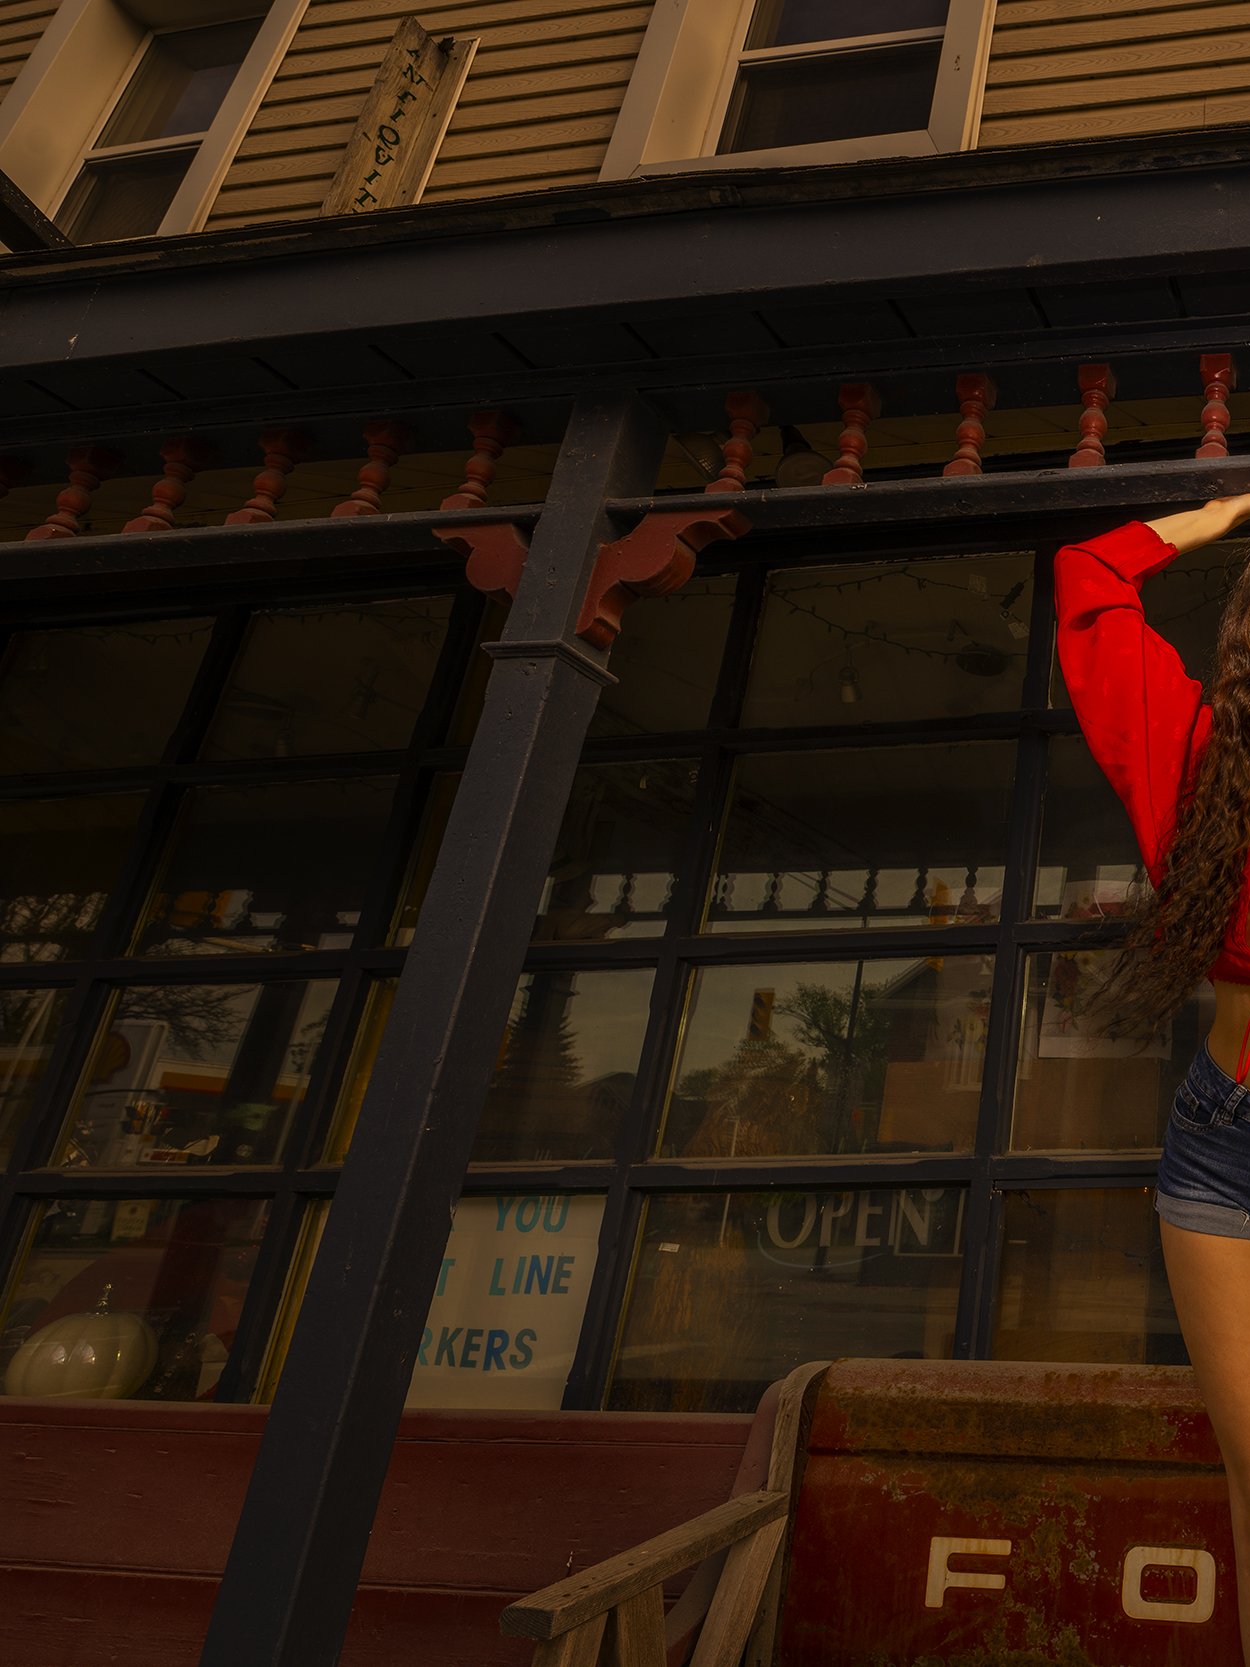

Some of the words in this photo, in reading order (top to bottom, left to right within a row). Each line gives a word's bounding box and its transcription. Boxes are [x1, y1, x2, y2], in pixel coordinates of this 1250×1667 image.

[353, 49, 425, 214] ANTIQUIT
[495, 1192, 570, 1233] YOU
[766, 1190, 930, 1249] OPEN
[488, 1254, 575, 1297] LINE
